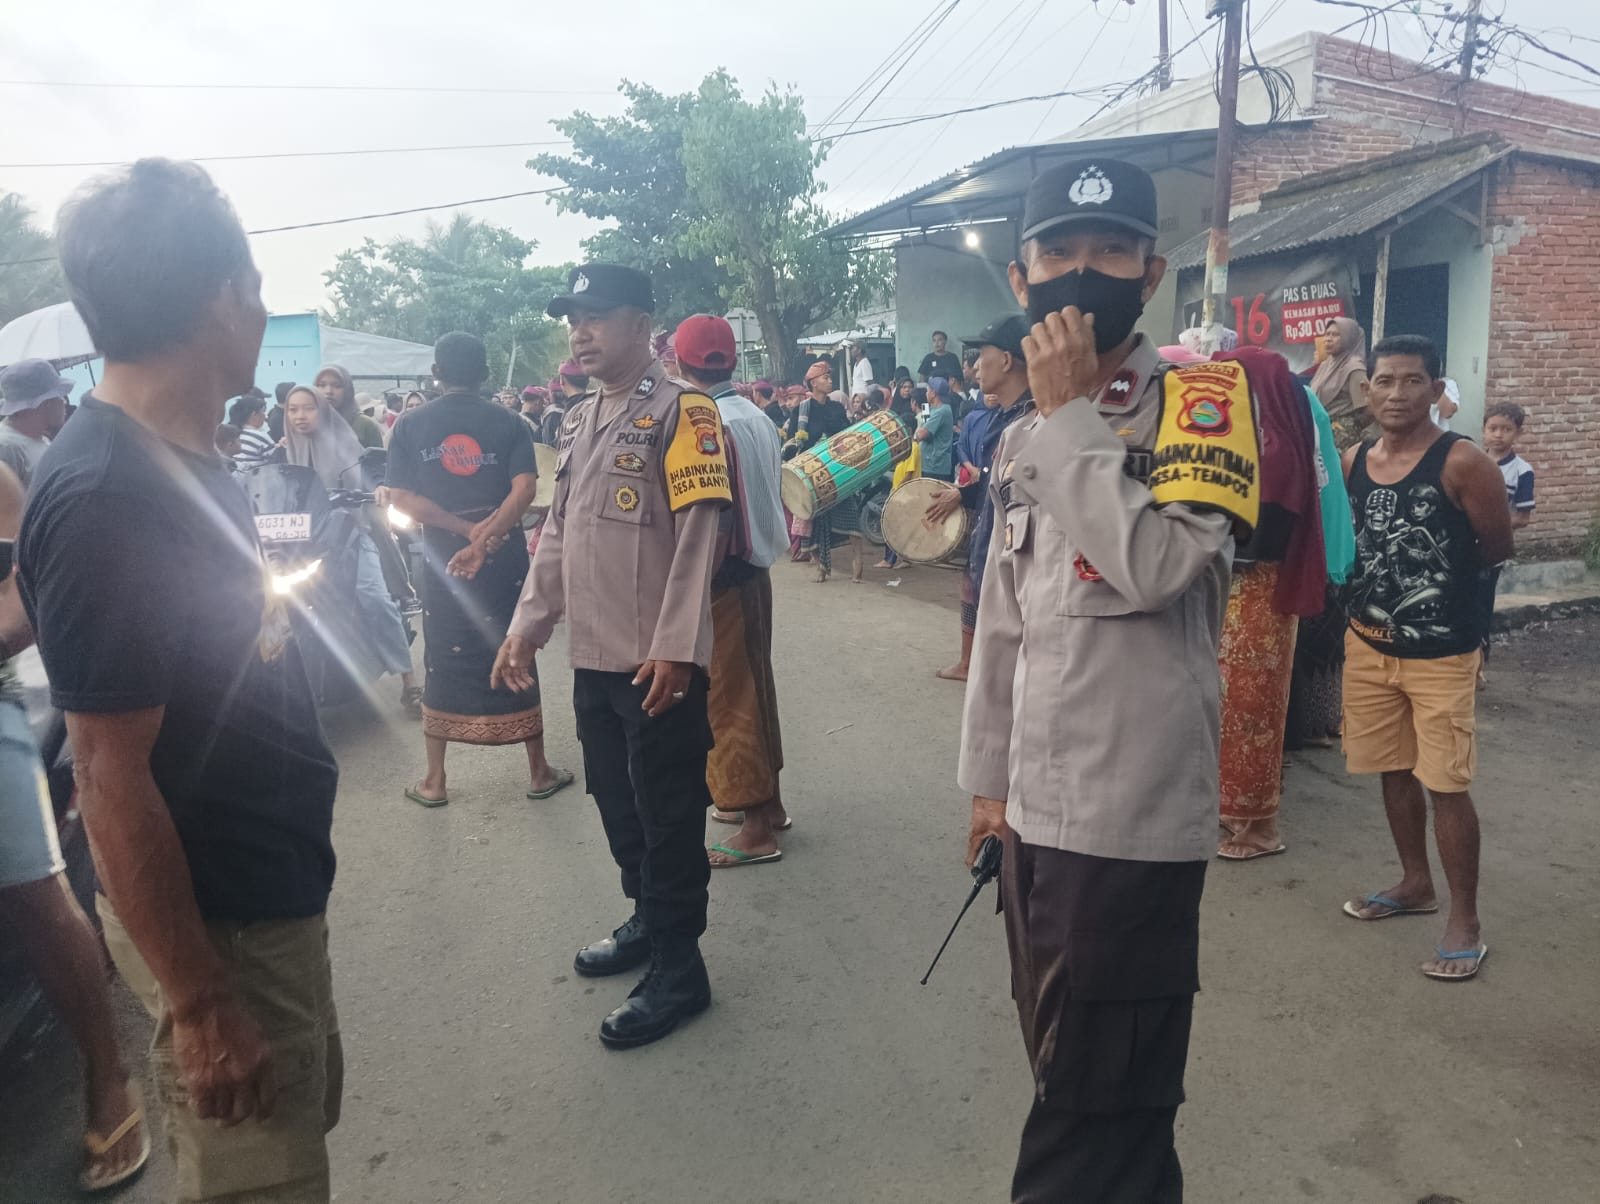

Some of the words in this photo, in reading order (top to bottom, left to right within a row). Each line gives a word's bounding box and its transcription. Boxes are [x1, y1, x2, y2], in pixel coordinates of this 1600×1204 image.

[1283, 288, 1299, 303] PAS
[1301, 286, 1308, 301] &
[1310, 282, 1337, 300] PUAS
[1231, 292, 1271, 346] 16
[1317, 303, 1340, 316] BARU
[673, 478, 696, 496] DESA
